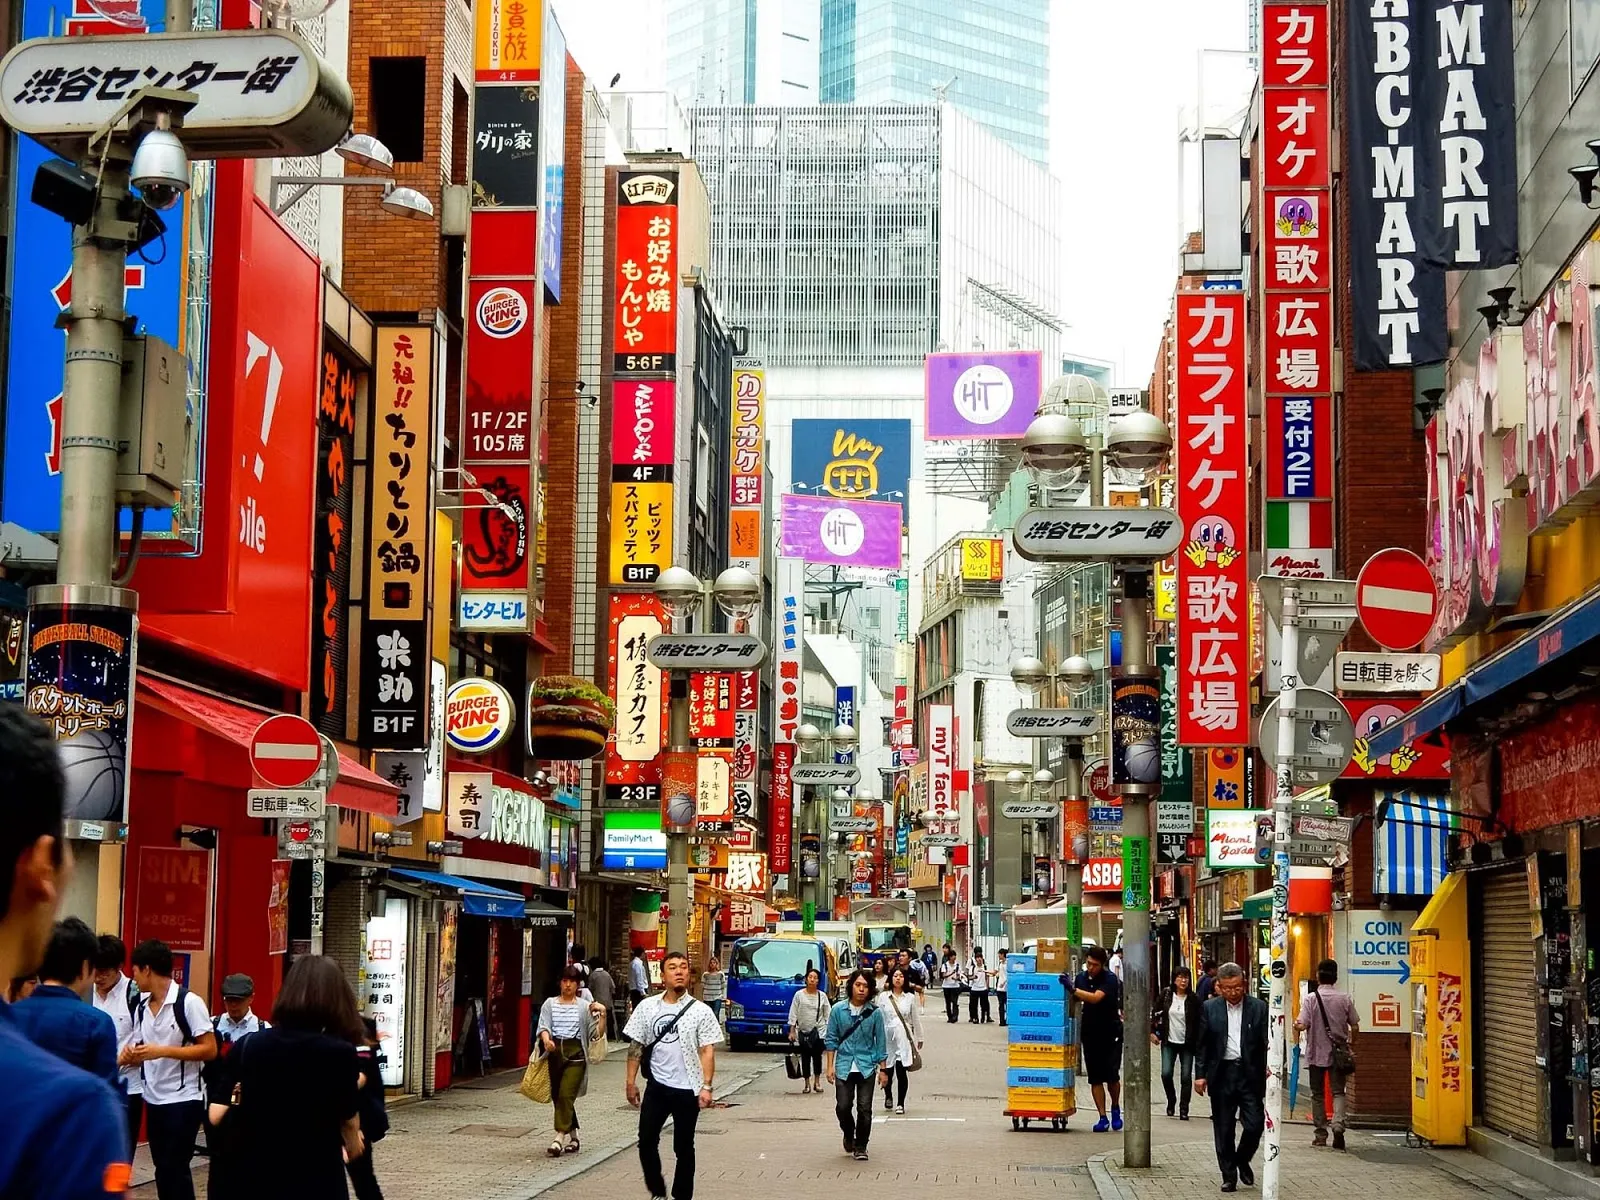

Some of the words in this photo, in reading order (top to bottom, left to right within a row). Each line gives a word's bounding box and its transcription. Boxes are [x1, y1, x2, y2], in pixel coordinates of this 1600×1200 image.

[13, 55, 299, 104] 渋谷センター街
[1276, 9, 1316, 178] カラオケ
[476, 130, 532, 154] ダリの家
[627, 181, 668, 197] 江戸前
[646, 216, 671, 313] お好み焼
[484, 298, 519, 315] BURGER
[620, 259, 644, 347] もんじゃ
[485, 306, 521, 326] KING
[1275, 244, 1319, 389] 歌広場
[1187, 297, 1237, 509] カラオケ
[735, 374, 761, 473] カラオケ
[472, 434, 526, 452] 105席
[633, 467, 653, 480] 4F
[735, 477, 759, 488] 受付
[377, 413, 421, 575] ちりとり鍋
[735, 490, 757, 503] 3F
[624, 486, 639, 562] スパゲッティ
[646, 502, 662, 554] ピッツァ
[1024, 520, 1173, 540] 渋谷センター街
[1270, 556, 1321, 570] Miami
[628, 568, 654, 580] B1F
[462, 600, 526, 620] センタービル
[653, 643, 758, 658] 渋谷センター街
[1187, 575, 1239, 731] 歌広場
[377, 629, 414, 703] 米助
[1342, 660, 1433, 683] 自転車を除く
[448, 696, 499, 715] BURGER
[702, 676, 716, 727] お好み焼
[447, 707, 500, 732] KING
[689, 690, 700, 736] もんじゃ
[1012, 716, 1095, 728] 渋谷センター街
[373, 716, 415, 733] B1F
[794, 769, 856, 778] 渋谷センター街
[459, 782, 483, 830] 寿司
[1005, 805, 1054, 813] 渋谷センター街
[607, 833, 653, 844] FamilyMart
[775, 834, 787, 842] 2F
[1162, 834, 1188, 845] B1F
[1210, 833, 1252, 844] Miami
[775, 846, 787, 854] 3F
[724, 854, 762, 890] 豚
[1364, 921, 1402, 936] COIN
[368, 994, 393, 1005] 寿司
